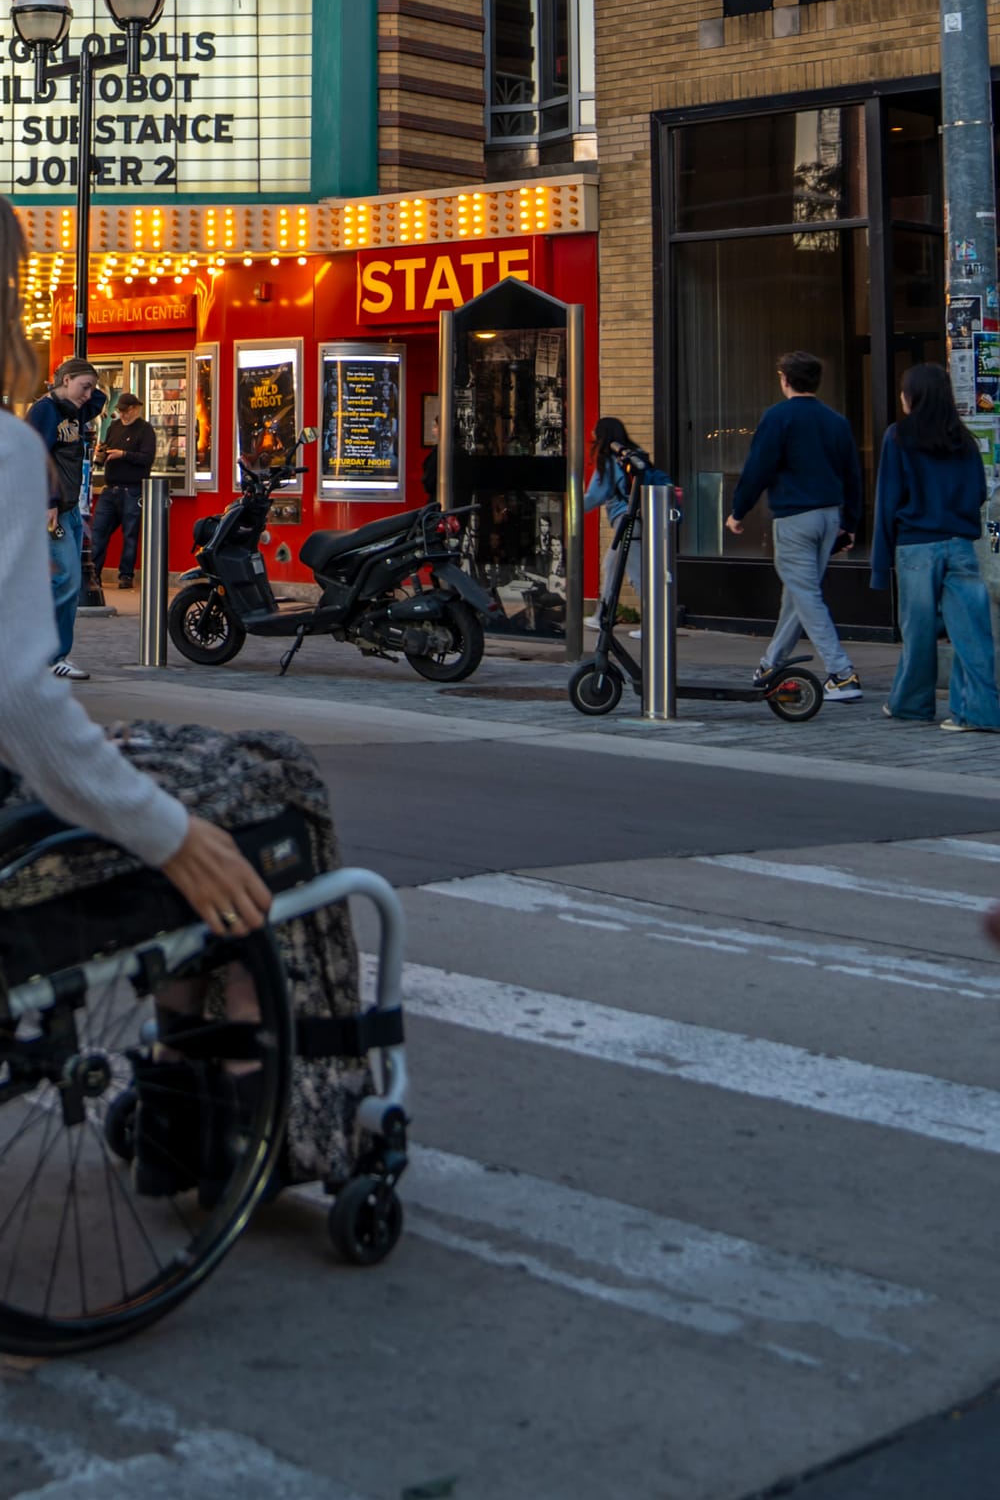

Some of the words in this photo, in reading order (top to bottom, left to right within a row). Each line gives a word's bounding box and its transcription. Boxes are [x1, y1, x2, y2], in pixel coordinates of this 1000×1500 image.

[154, 155, 177, 186] 2
[117, 307, 143, 322] FILM
[144, 304, 187, 320] CENTER
[254, 384, 278, 397] WILD
[250, 395, 282, 409] ROBOT
[368, 458, 391, 466] NIGHT
